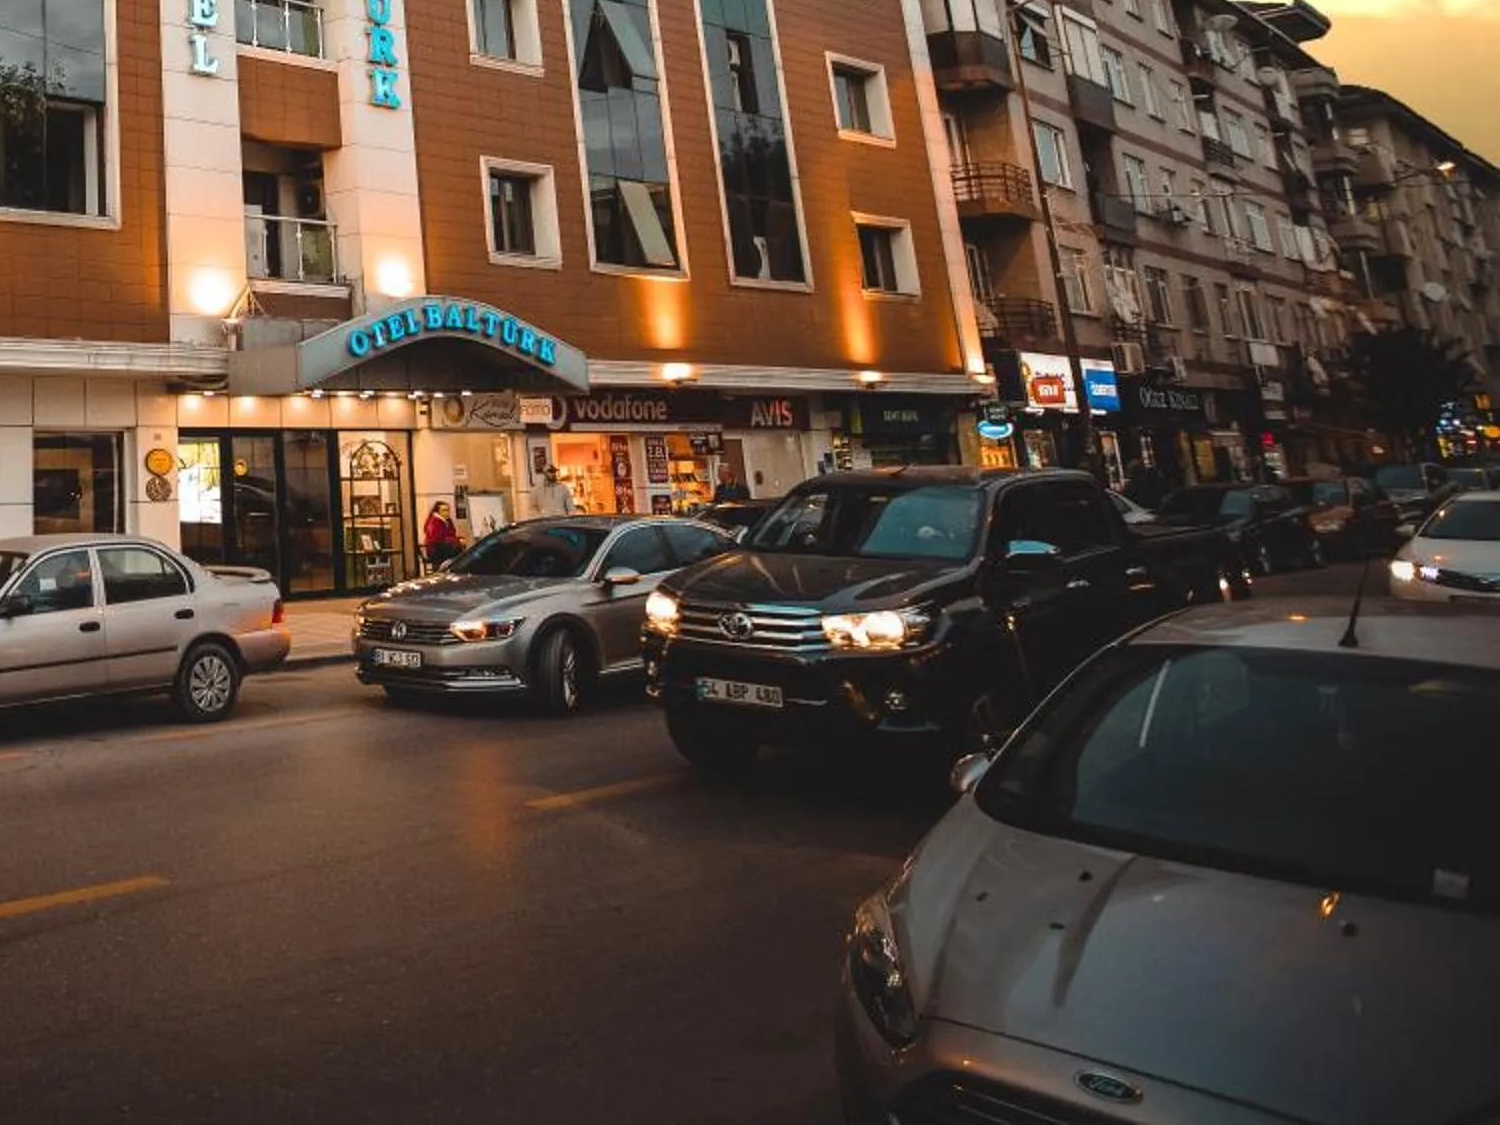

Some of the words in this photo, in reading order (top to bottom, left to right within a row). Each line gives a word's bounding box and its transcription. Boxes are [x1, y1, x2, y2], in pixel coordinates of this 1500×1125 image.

[348, 308, 421, 357] OTEL
[424, 302, 558, 366] BALTÜRK
[574, 397, 668, 421] vodafone
[751, 399, 793, 426] AVIS
